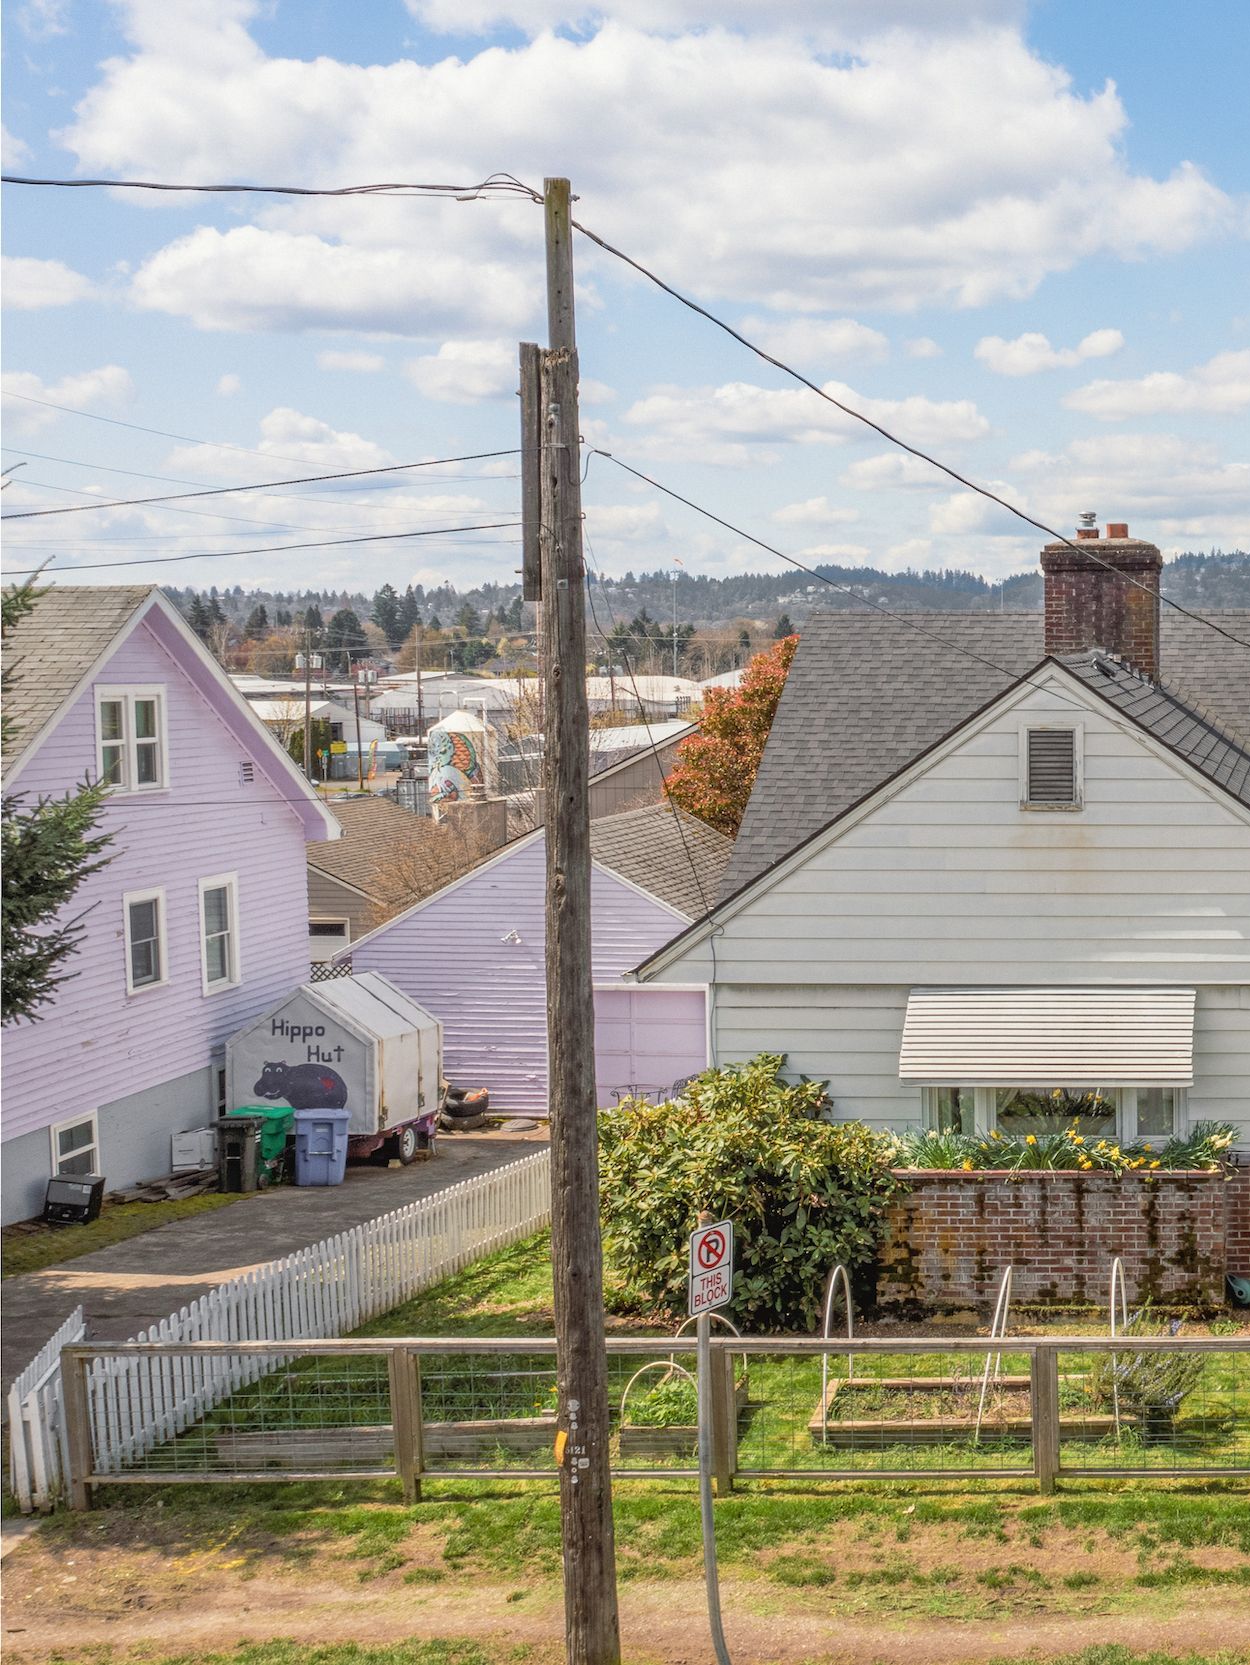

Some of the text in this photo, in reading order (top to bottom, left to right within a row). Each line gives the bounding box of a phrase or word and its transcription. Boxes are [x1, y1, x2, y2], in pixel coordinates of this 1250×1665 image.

[271, 1018, 325, 1043] Hippo
[307, 1045, 344, 1062] Hut
[700, 1272, 722, 1291] THIS
[694, 1283, 727, 1308] BLOCK
